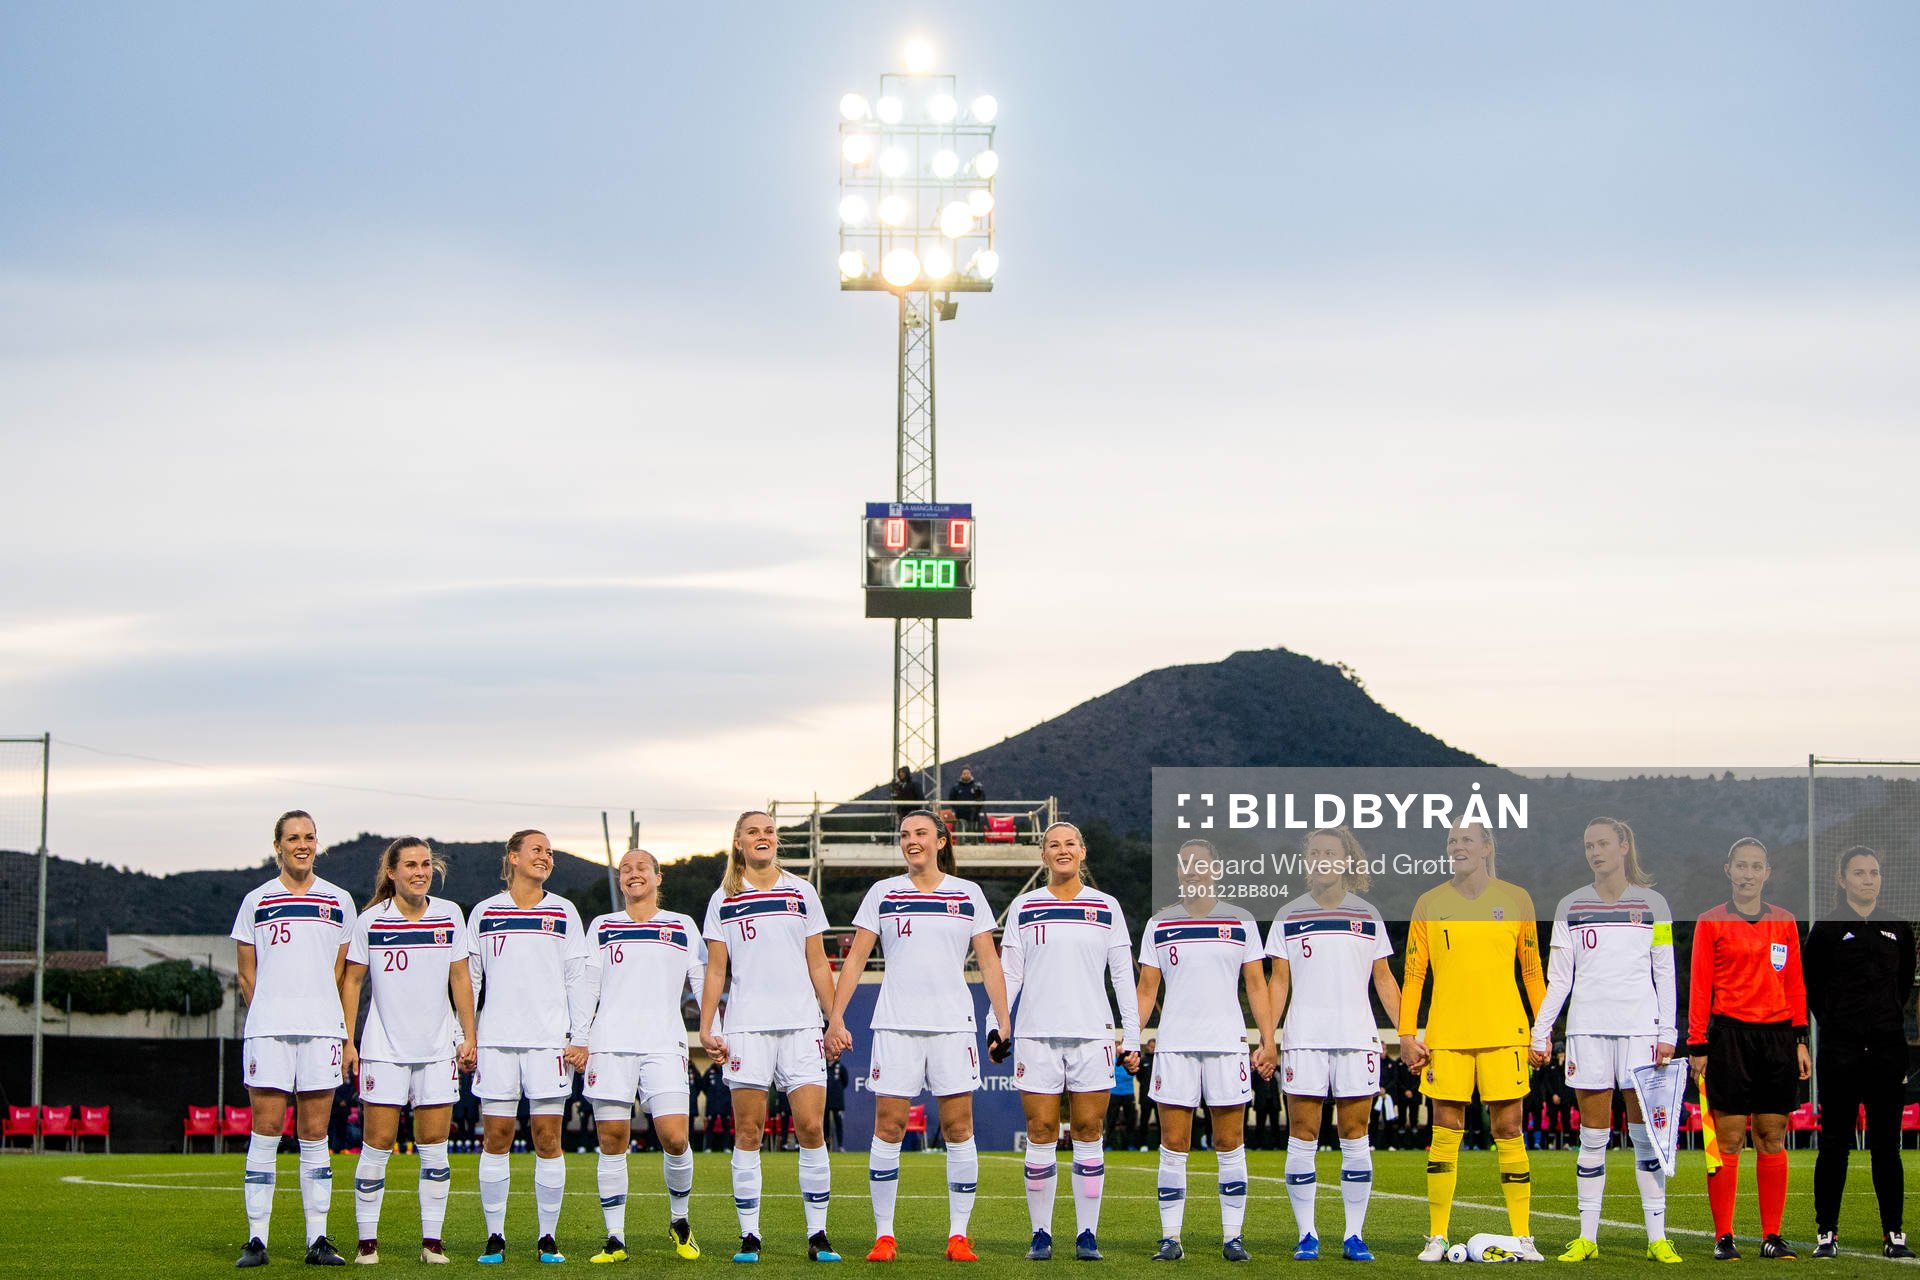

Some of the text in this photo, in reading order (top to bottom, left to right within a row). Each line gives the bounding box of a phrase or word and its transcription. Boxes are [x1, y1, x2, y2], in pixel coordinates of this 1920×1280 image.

[886, 518, 905, 548] 0
[950, 519, 970, 548] 0
[900, 559, 955, 588] 0:00
[269, 922, 291, 945] 25
[738, 919, 757, 941] 15
[896, 918, 912, 938] 14
[1035, 925, 1046, 945] 11
[493, 935, 507, 957] 17
[1302, 938, 1313, 958] 5
[1443, 929, 1450, 950] 1
[1582, 930, 1597, 950] 10
[384, 950, 409, 972] 20
[609, 944, 624, 965] 16
[1169, 946, 1179, 966] 8
[1103, 1045, 1115, 1067] 11
[1366, 1052, 1376, 1074] 5
[1514, 1051, 1520, 1072] 1
[1650, 1044, 1659, 1062] 1
[1239, 1061, 1248, 1082] 8
[980, 1075, 1019, 1091] NTRE
